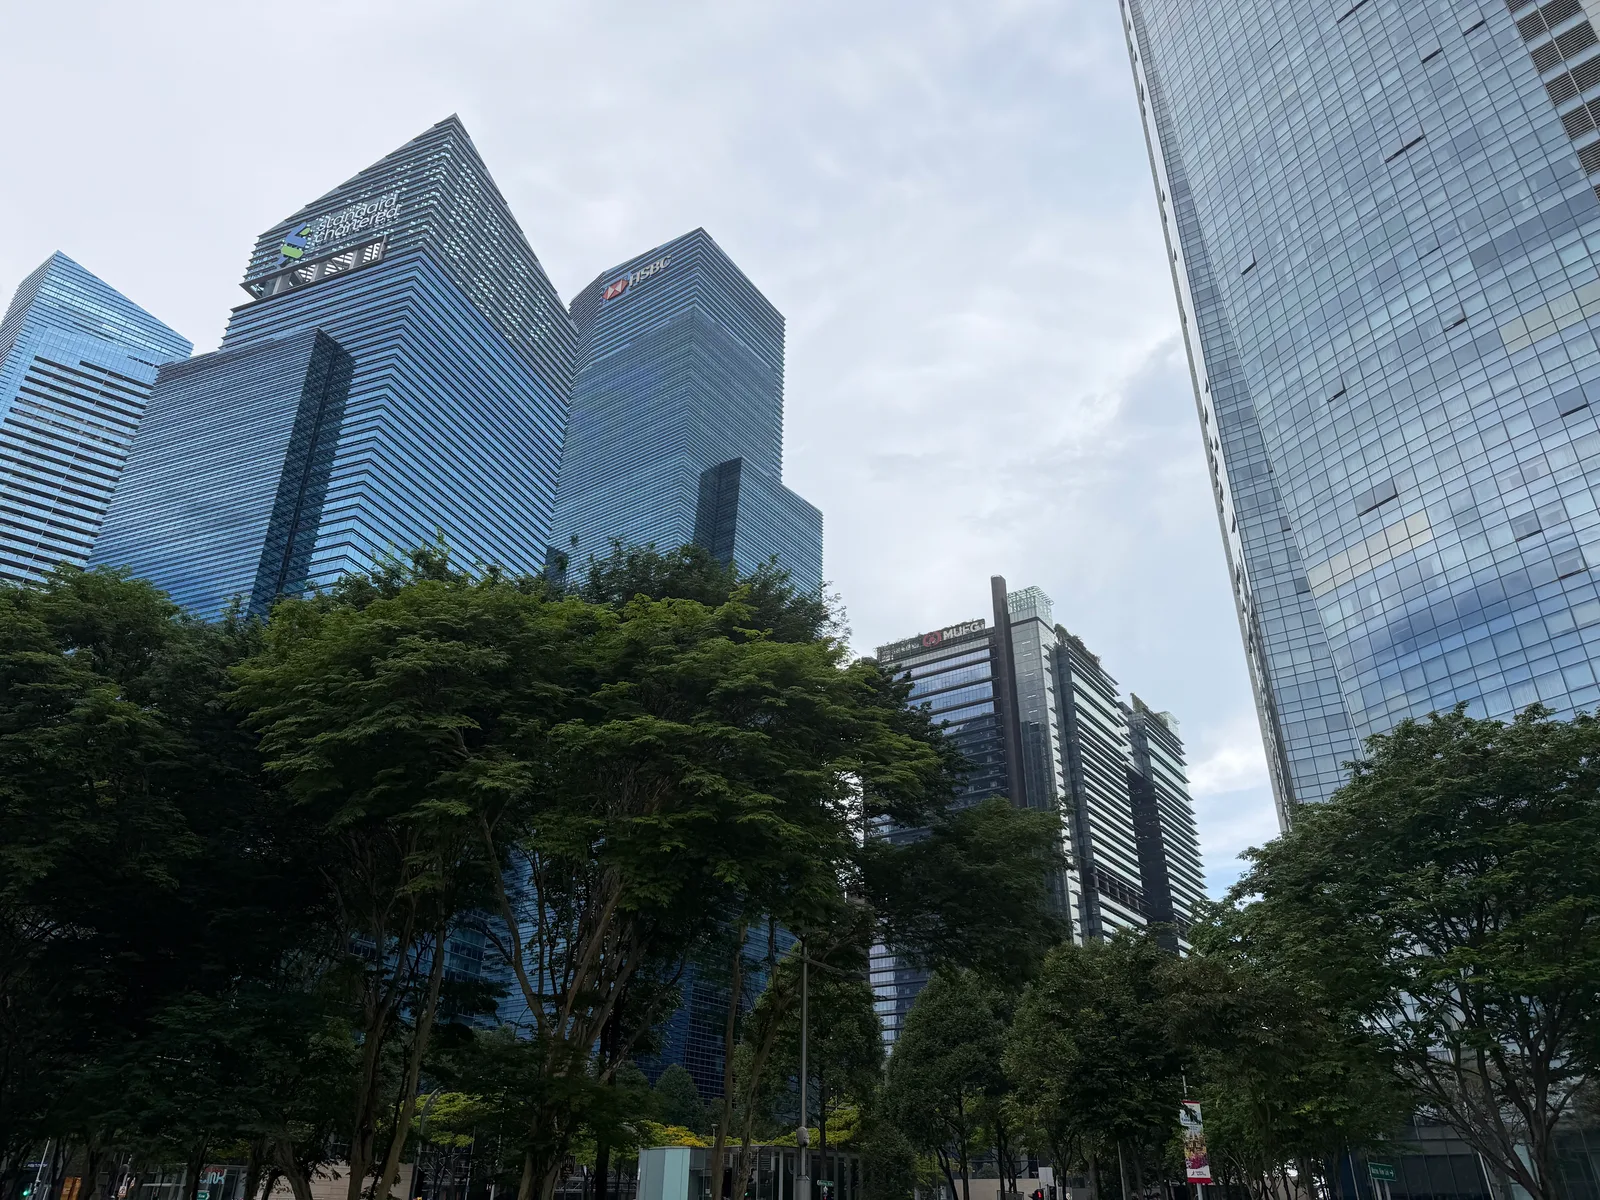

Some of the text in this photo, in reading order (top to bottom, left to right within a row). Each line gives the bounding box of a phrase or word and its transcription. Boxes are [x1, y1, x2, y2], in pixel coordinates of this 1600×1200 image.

[315, 204, 399, 243] chartered
[317, 193, 397, 231] standard
[628, 255, 671, 286] HSBC
[943, 622, 980, 640] MUFG
